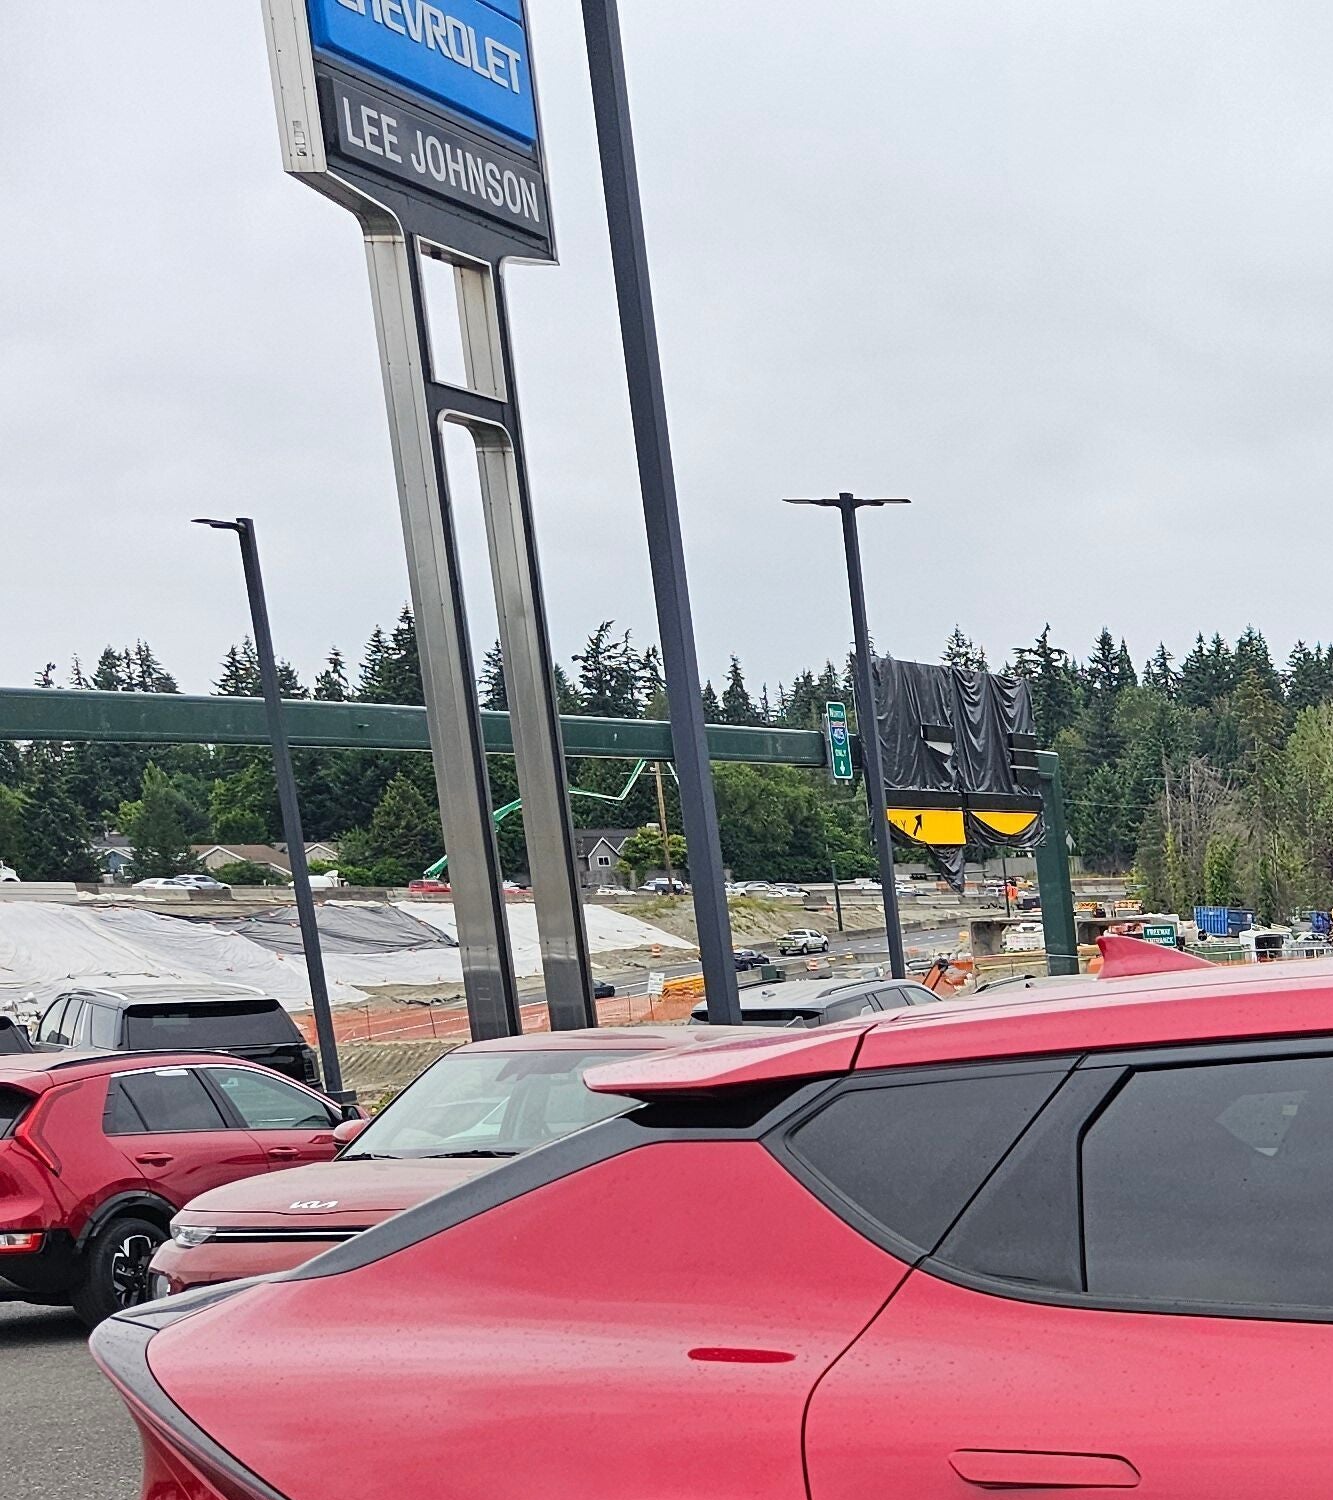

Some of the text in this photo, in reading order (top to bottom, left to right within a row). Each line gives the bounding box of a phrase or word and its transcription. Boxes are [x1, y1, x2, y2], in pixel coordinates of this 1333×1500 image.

[338, 0, 520, 94] EVROLET
[343, 97, 540, 222] LEE JOHNSON
